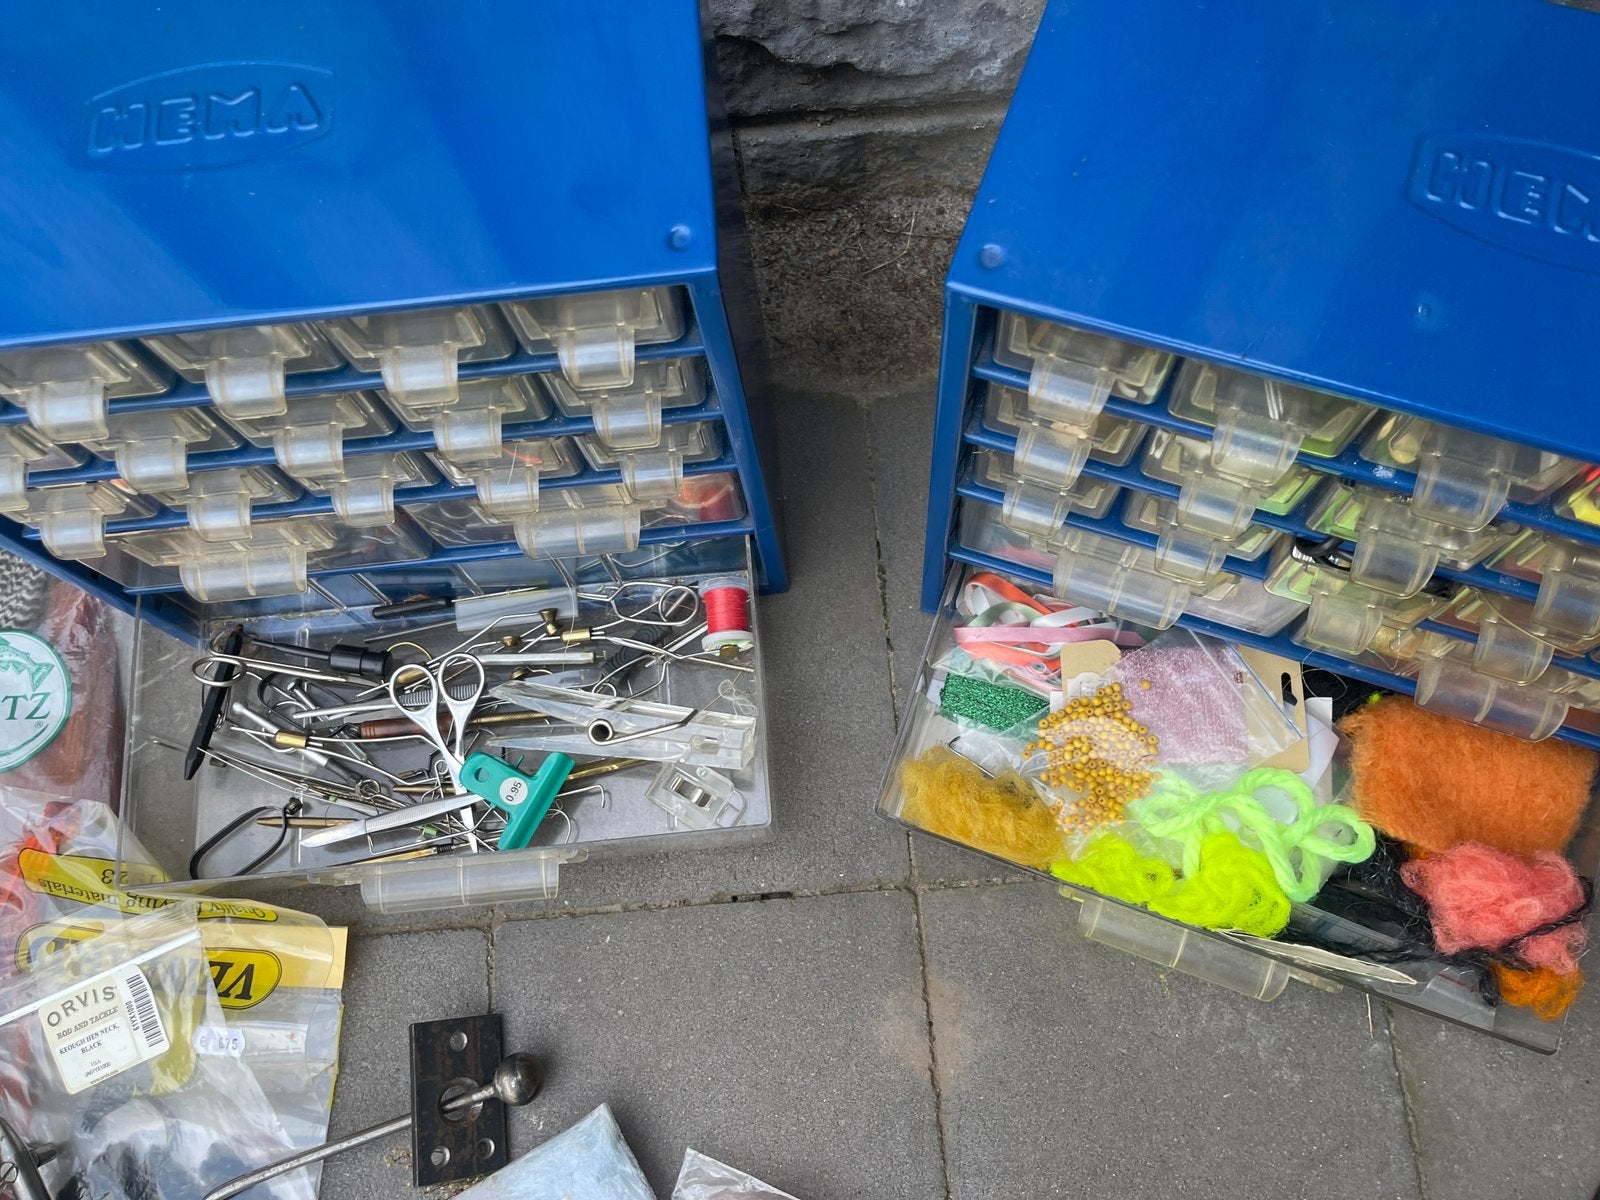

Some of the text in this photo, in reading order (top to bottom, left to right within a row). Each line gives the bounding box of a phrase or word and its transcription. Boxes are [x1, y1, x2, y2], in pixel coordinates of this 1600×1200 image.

[93, 83, 322, 154] HEMA
[505, 780, 522, 802] 0.95
[46, 985, 116, 1028] ORVIS
[56, 1006, 119, 1041] ROD AND TACKLE
[58, 1037, 87, 1056] KEOUGH
[86, 1030, 100, 1043] HEN
[80, 1040, 103, 1055] BLACK
